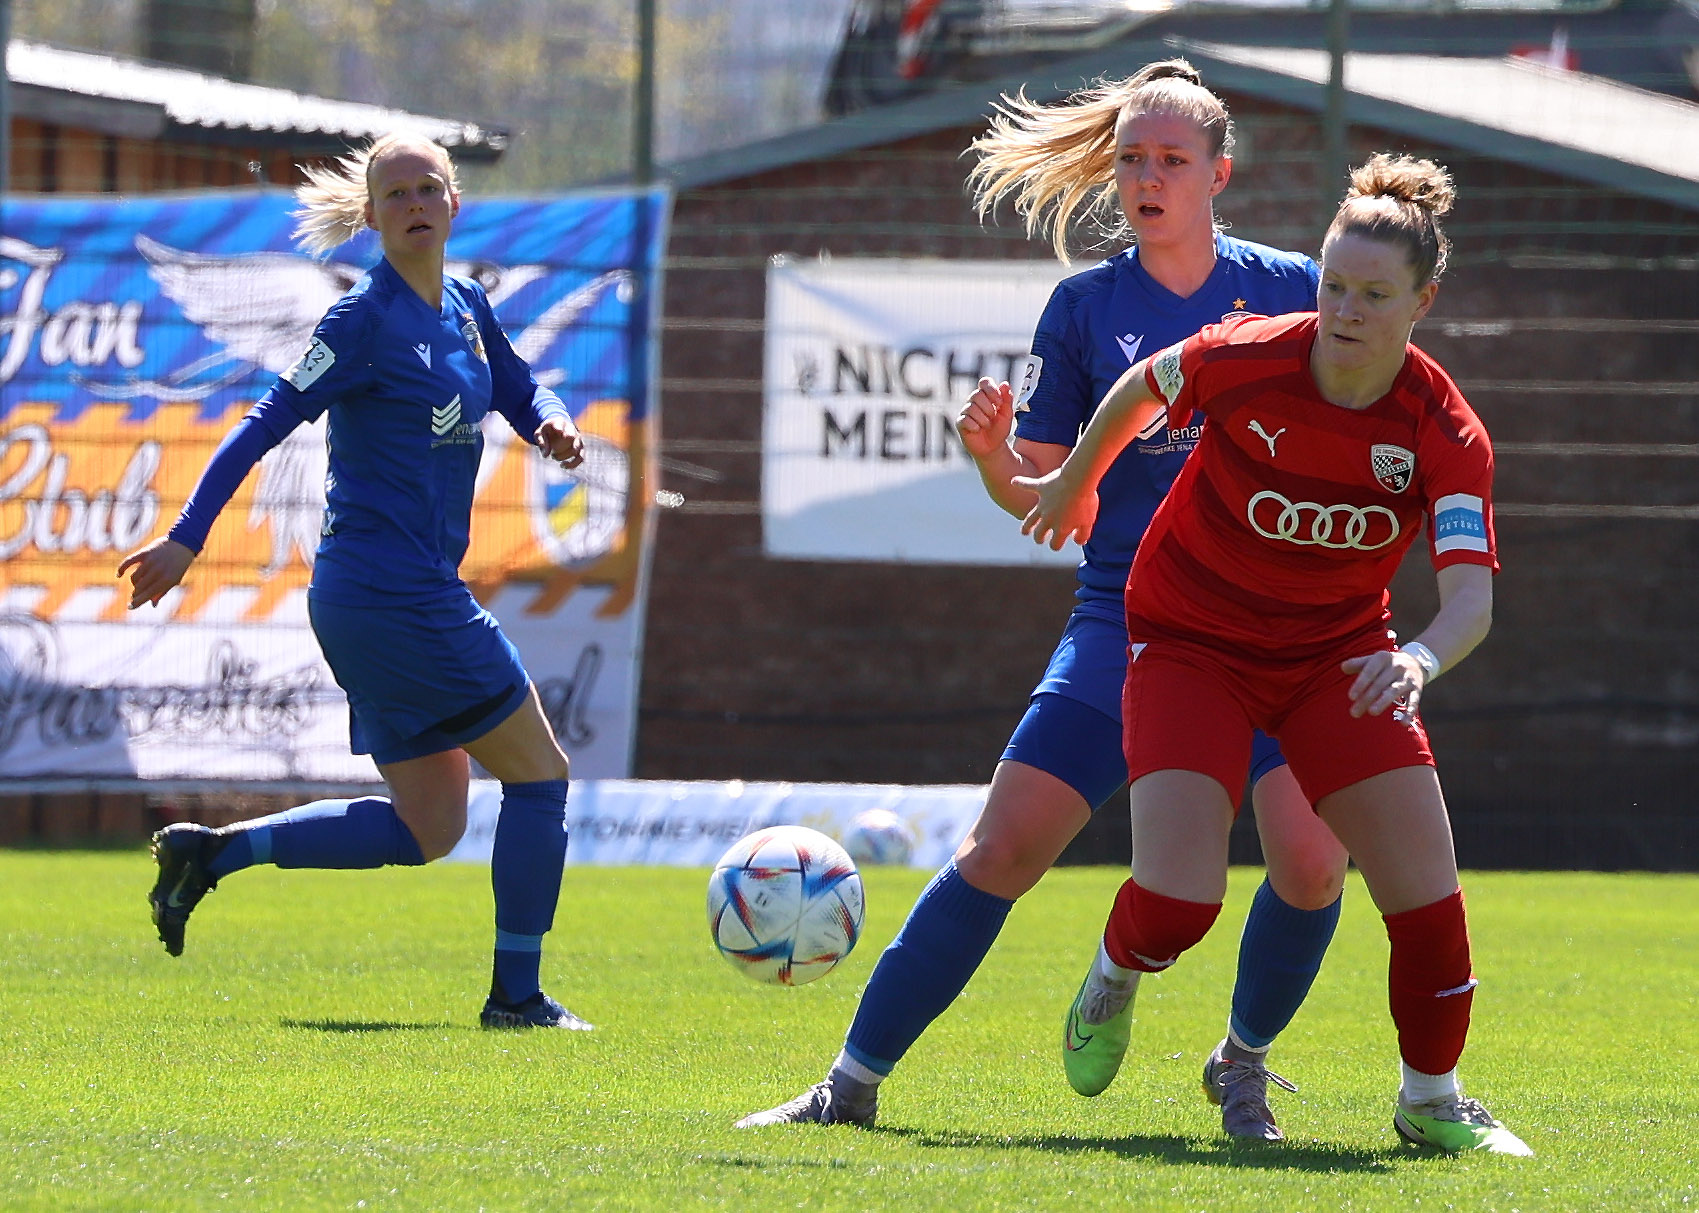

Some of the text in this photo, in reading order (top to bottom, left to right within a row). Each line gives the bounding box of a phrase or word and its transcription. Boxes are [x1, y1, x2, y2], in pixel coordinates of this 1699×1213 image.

[0, 236, 146, 384] Fan
[833, 346, 1029, 399] NICHT
[1439, 520, 1480, 533] PETERS
